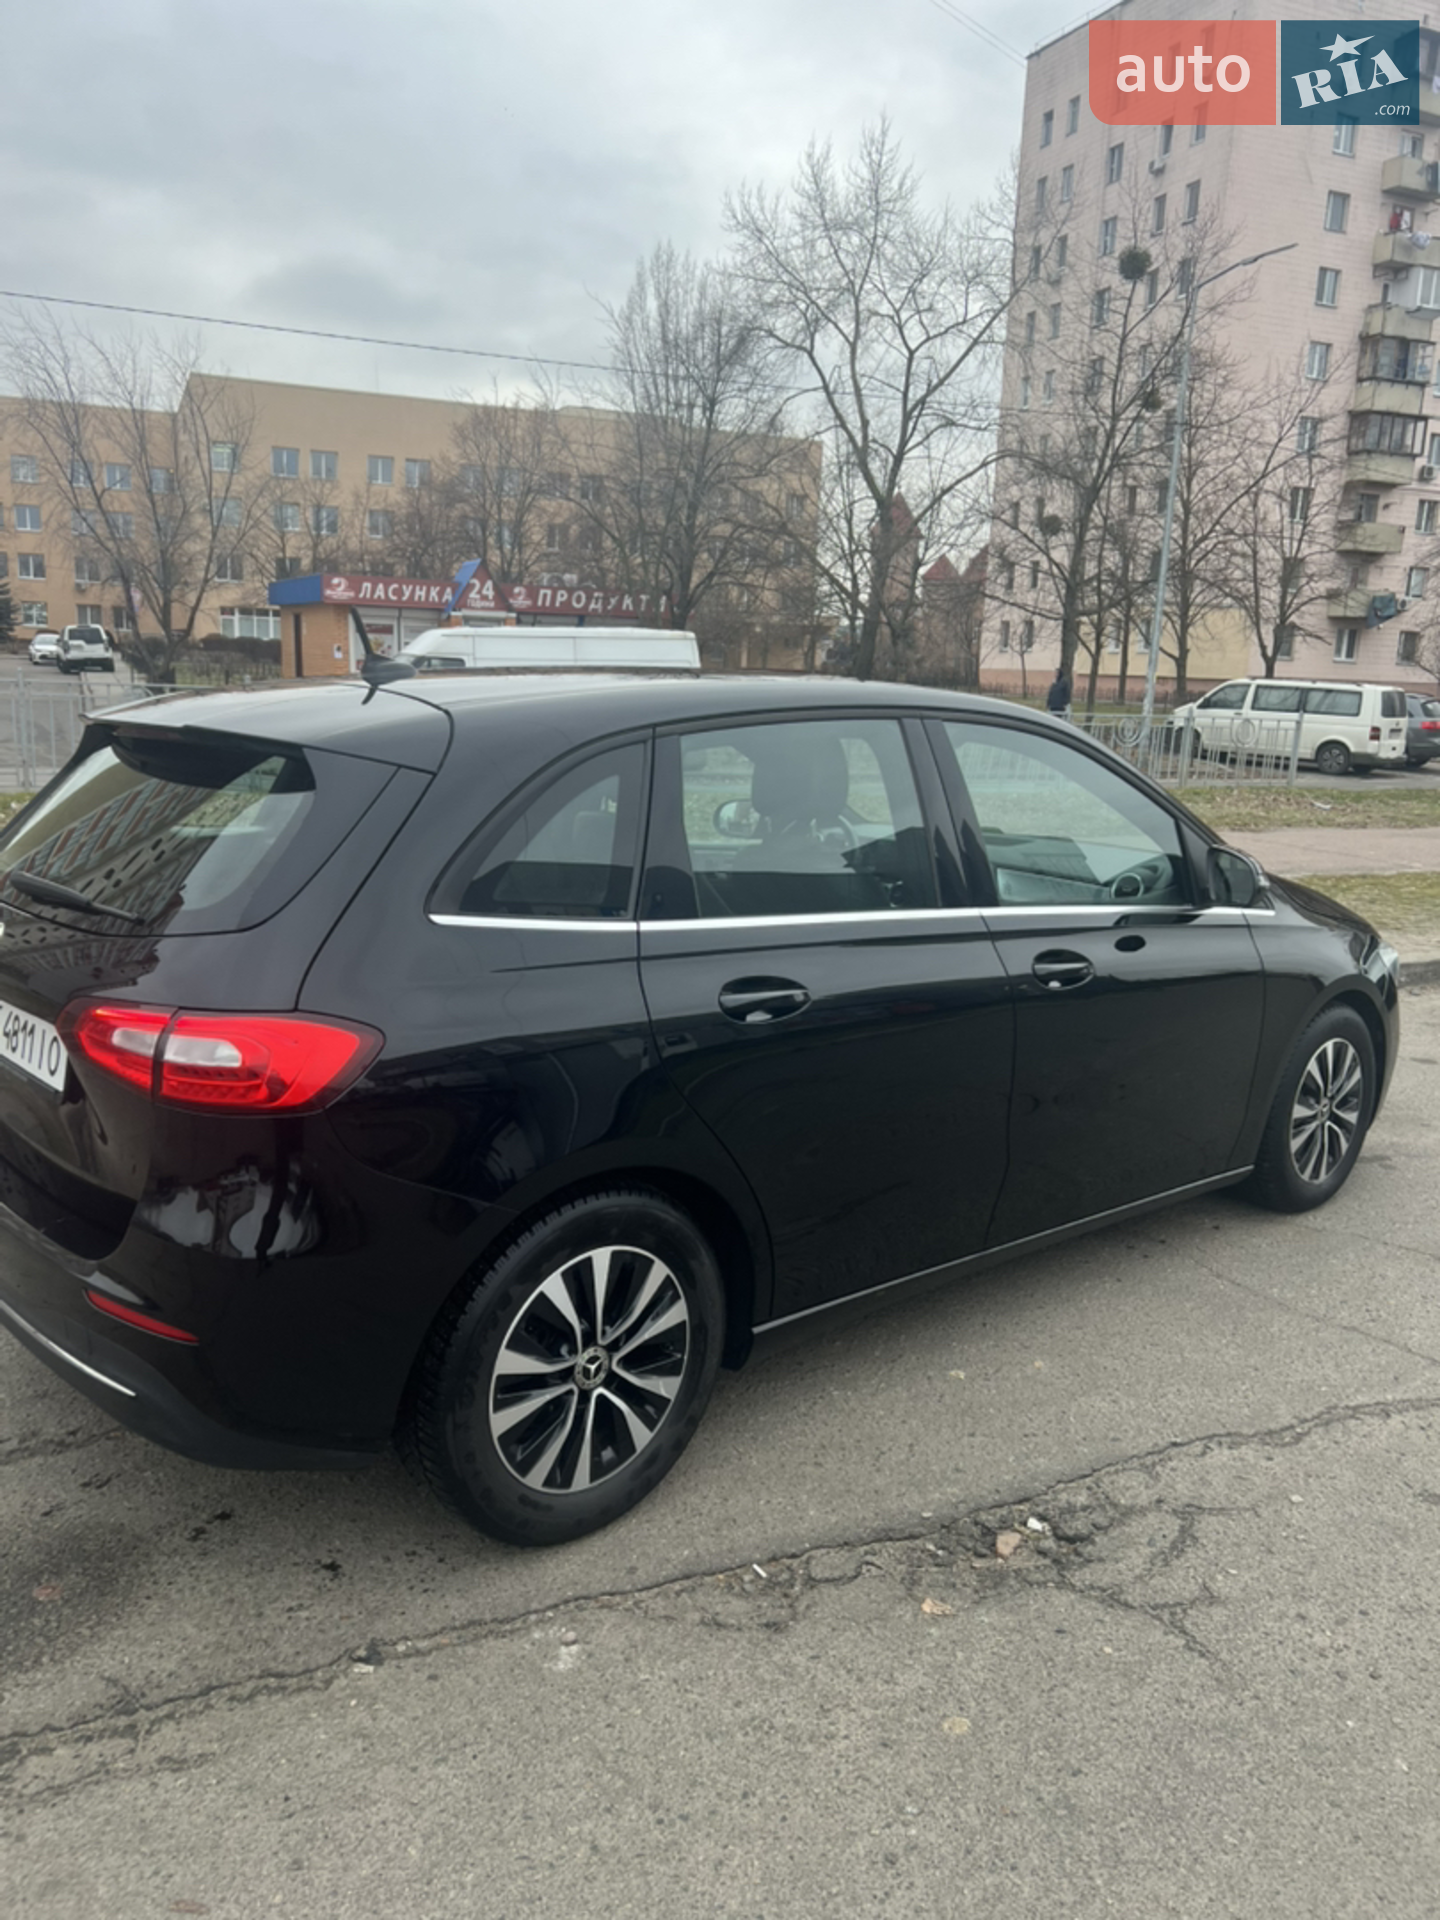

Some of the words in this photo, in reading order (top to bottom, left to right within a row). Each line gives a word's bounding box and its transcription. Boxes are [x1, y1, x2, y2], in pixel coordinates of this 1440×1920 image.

[358, 582, 453, 603] ЛАСУНКА
[468, 578, 496, 600] 24
[3, 1010, 36, 1064] 4811
[38, 1029, 61, 1077] IO
